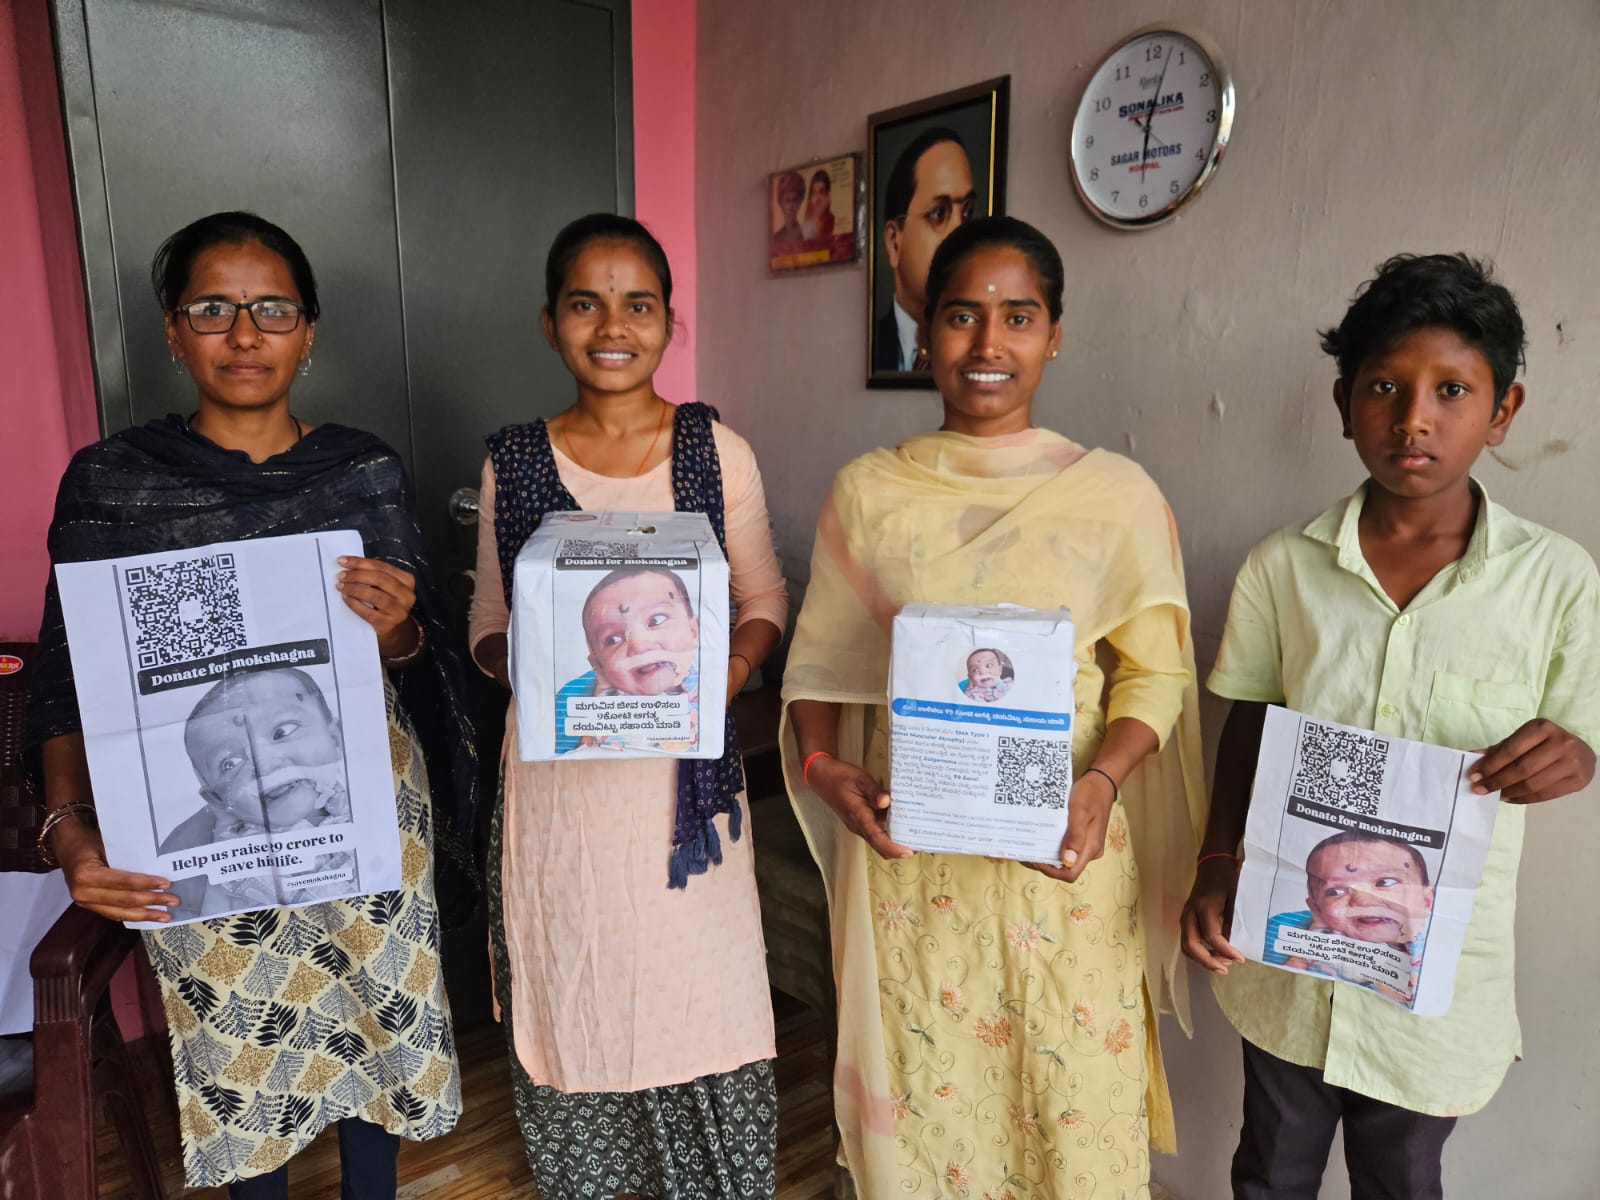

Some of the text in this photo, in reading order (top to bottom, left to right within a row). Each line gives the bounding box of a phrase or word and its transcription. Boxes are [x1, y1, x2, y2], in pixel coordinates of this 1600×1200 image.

[1146, 45, 1162, 62] 12
[1178, 52, 1185, 65] 1
[1116, 66, 1131, 81] 11
[1200, 73, 1209, 88] 2
[1095, 97, 1111, 113] 10
[1206, 109, 1216, 123] 3
[1086, 135, 1094, 148] 9
[1111, 151, 1140, 166] SAGAR
[1195, 148, 1205, 161] 4
[1090, 168, 1099, 181] 8
[1170, 180, 1179, 194] 5
[1111, 191, 1120, 203] 7
[1139, 195, 1148, 208] 6
[624, 558, 688, 567] mokshagna
[151, 648, 316, 687] Donate for mokshagna
[575, 700, 681, 711] ಮಗುವಿನ ಜೀವ ಉಳಿಸಲು
[633, 710, 659, 722] ಅಗತ್ಯ
[573, 720, 682, 734] ದಯವಿಟ್ಟು ಸಹಾಯ ಮಾಡಿ
[1296, 803, 1432, 843] Donate for mokshagna
[172, 855, 208, 872] Help
[211, 850, 229, 862] us
[232, 842, 270, 858] raise
[286, 835, 327, 850] crore
[329, 833, 344, 844] to
[220, 860, 255, 875] save
[275, 854, 303, 868] life.
[1287, 930, 1401, 963] ಮಗುವಿನ ಜೀವ ಉಳಿಸಲು
[1282, 945, 1399, 979] ದಯವಿಟ್ಟು ಸಹಾಯ ಮಾಡಿ
